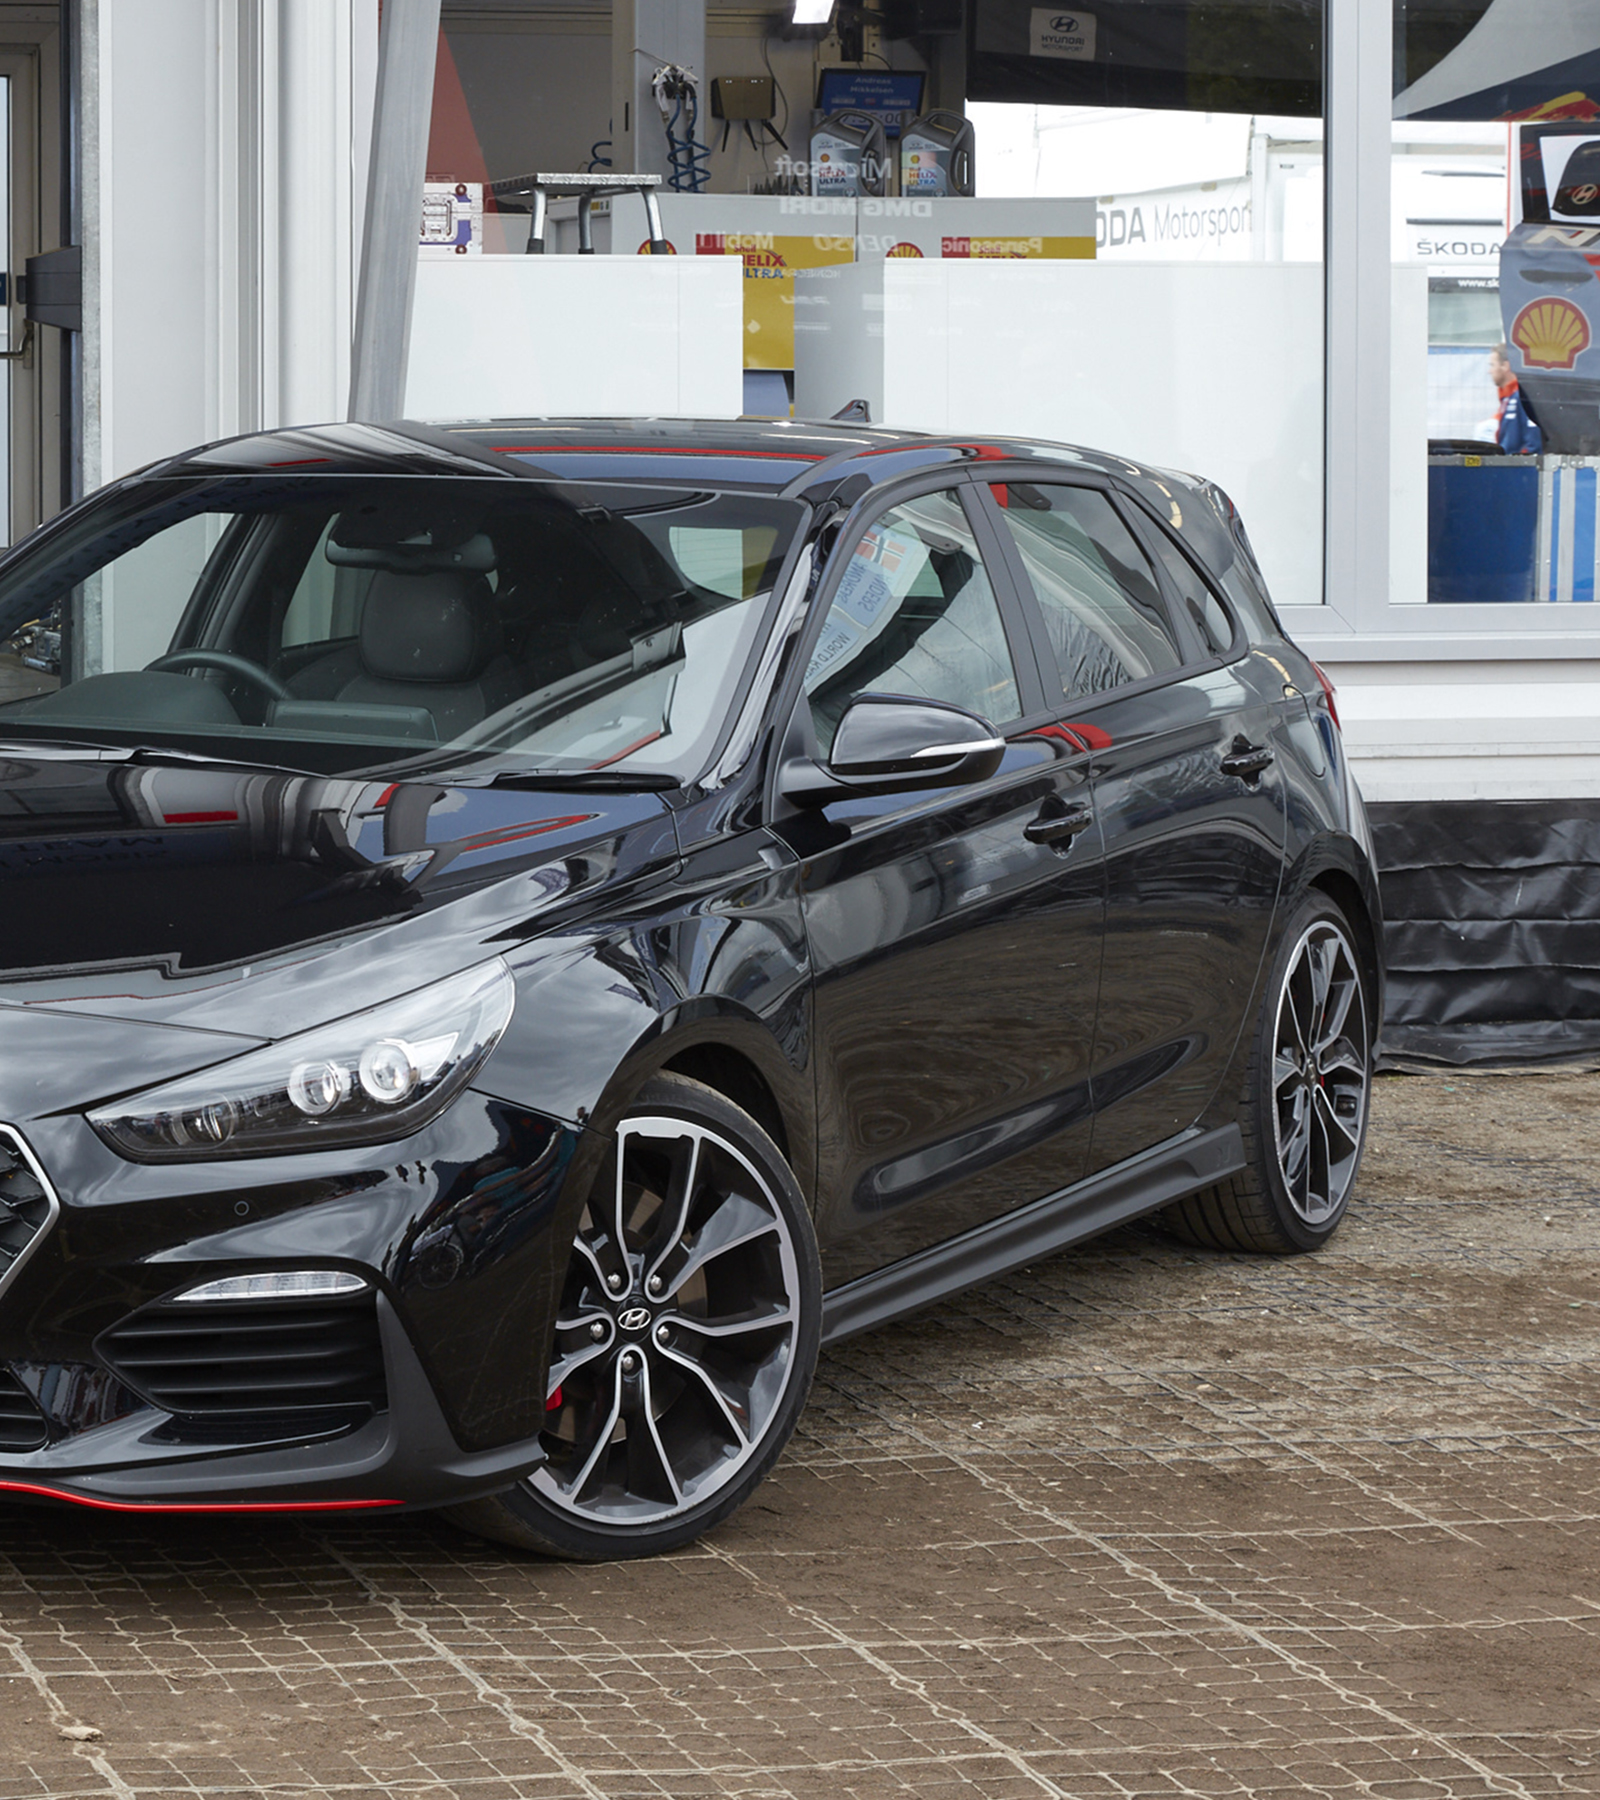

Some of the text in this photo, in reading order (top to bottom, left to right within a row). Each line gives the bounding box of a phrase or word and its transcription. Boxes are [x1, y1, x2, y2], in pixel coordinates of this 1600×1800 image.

[1041, 35, 1085, 46] HYUNDAI
[1041, 43, 1084, 53] MOTORSPORT
[908, 171, 937, 179] HELIX
[818, 177, 847, 185] ULTRA
[908, 178, 936, 186] ULTRA
[1095, 202, 1252, 249] ODA Motorspor
[1416, 237, 1501, 256] ŠKODA
[742, 267, 784, 279] LTRA
[1456, 278, 1500, 289] www.sk
